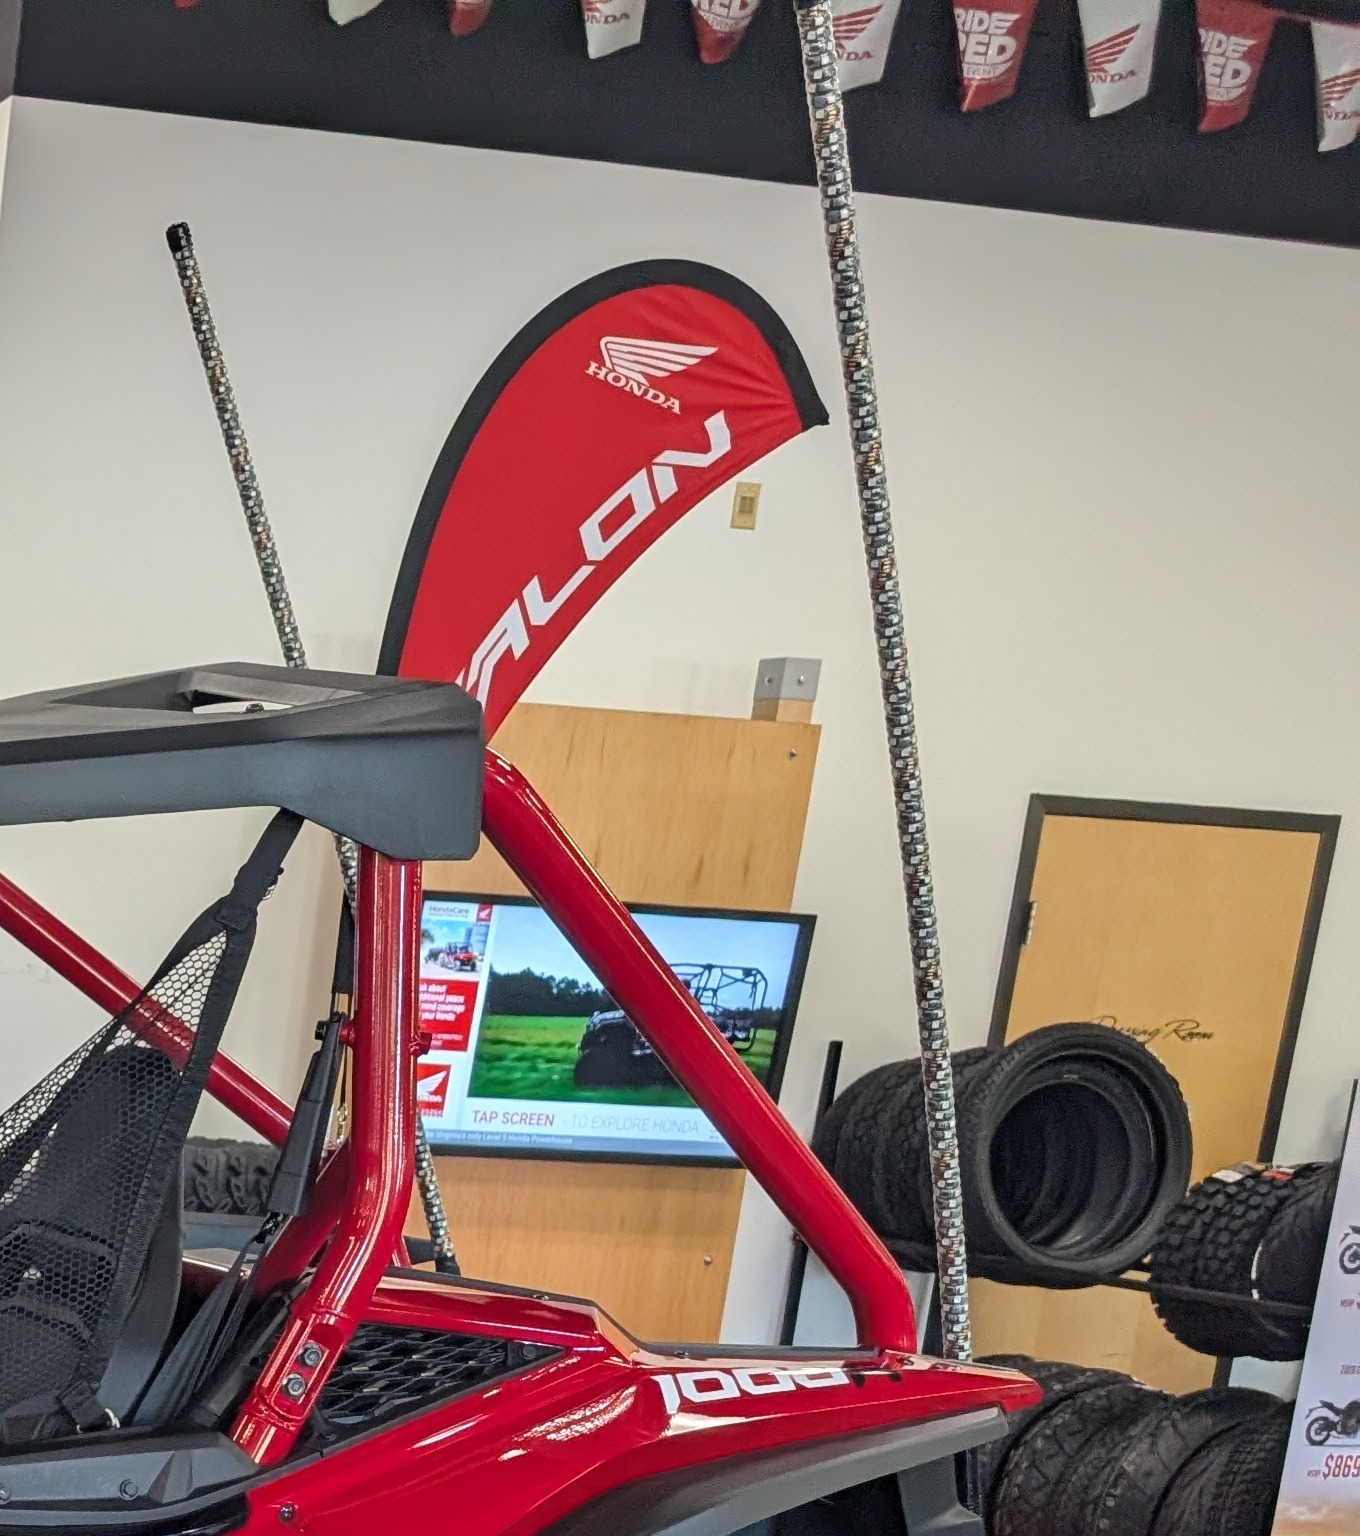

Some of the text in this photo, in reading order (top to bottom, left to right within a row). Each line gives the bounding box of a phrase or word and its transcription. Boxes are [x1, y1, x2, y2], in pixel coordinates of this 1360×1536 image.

[584, 360, 682, 415] HONDA
[455, 410, 731, 713] ALON
[472, 1110, 498, 1125] TAP
[501, 1111, 555, 1127] SCREEN
[572, 1114, 589, 1128] TO
[591, 1115, 651, 1130] EXPLORE
[652, 1119, 700, 1134] HONDA
